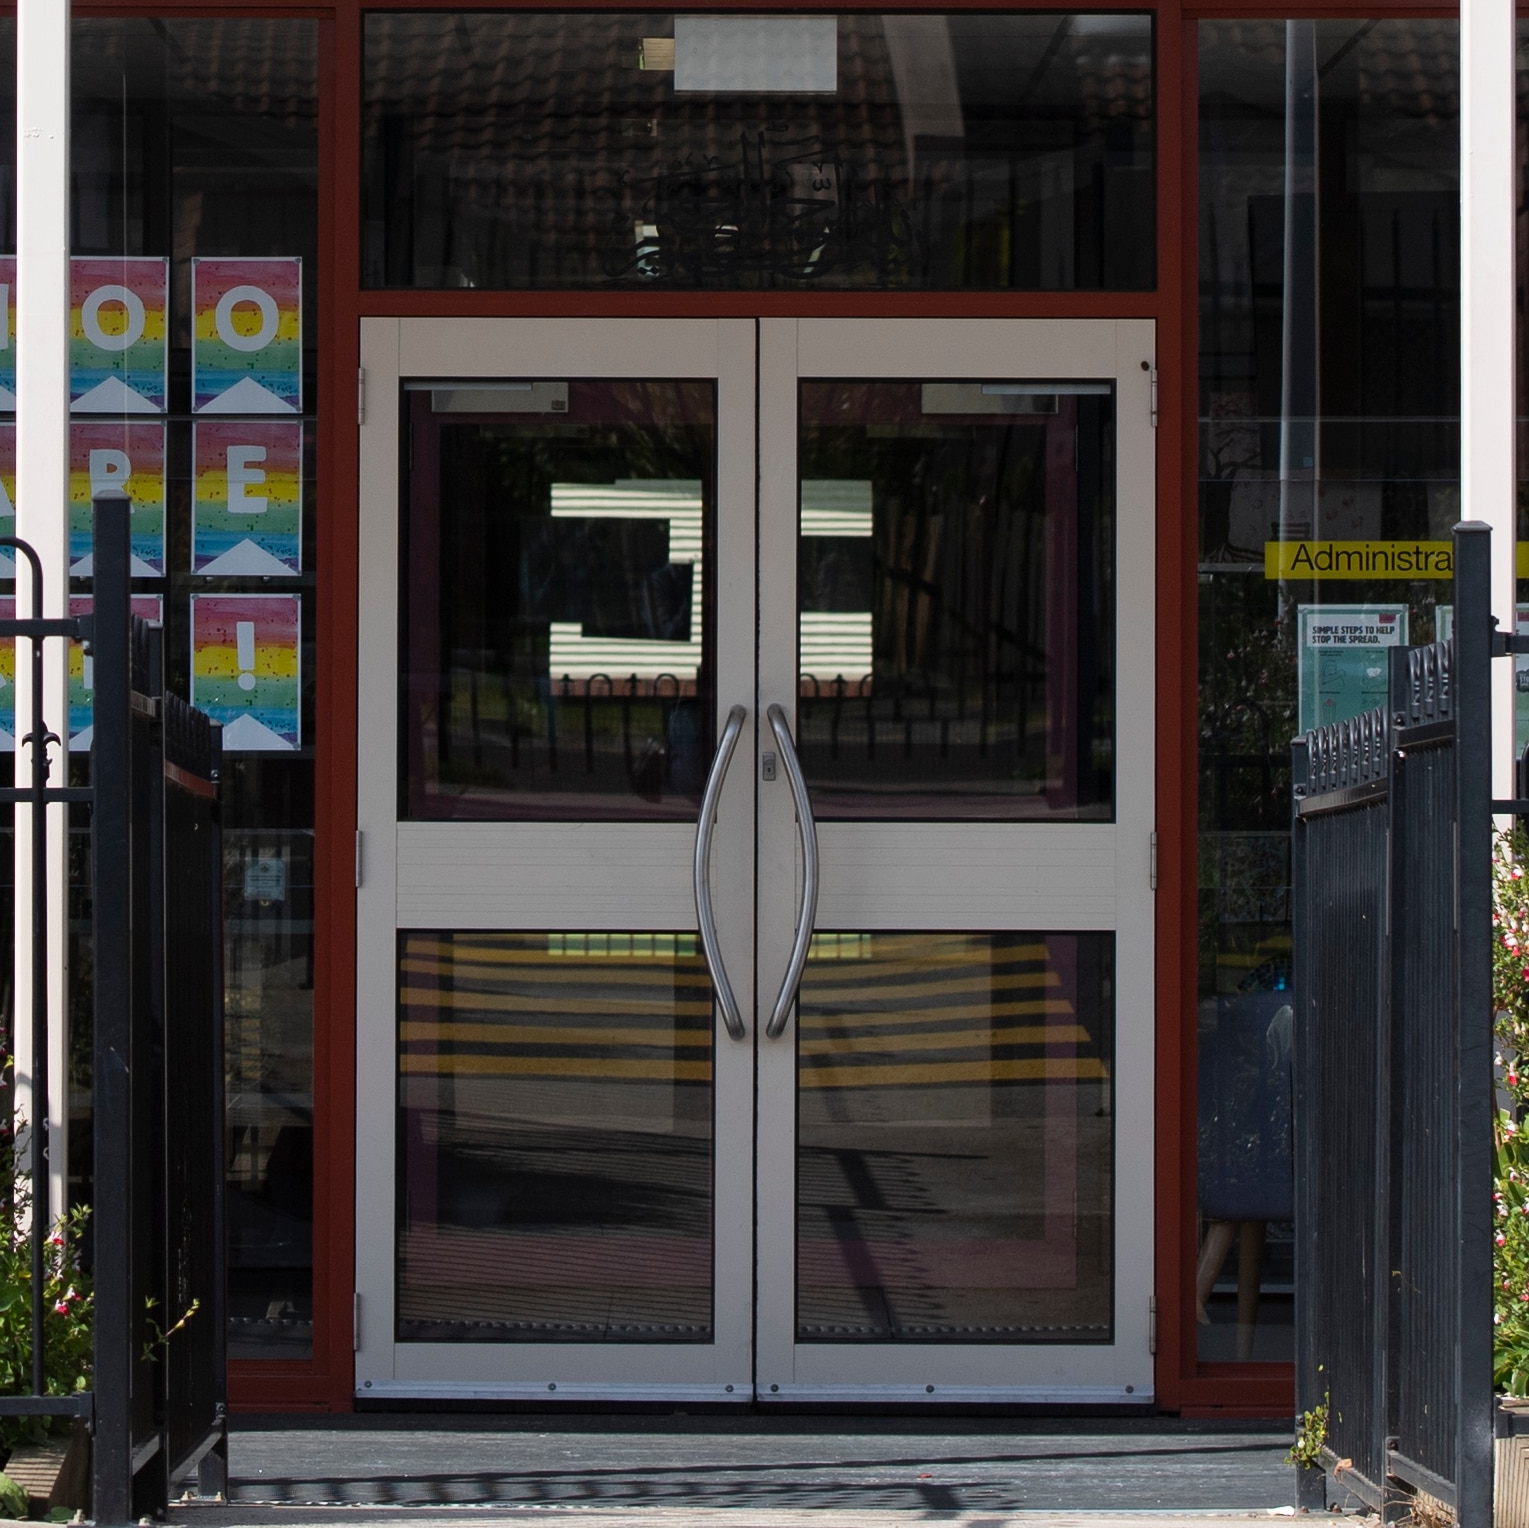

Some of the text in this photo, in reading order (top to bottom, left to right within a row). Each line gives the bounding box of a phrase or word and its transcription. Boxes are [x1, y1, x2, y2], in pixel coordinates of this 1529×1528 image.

[1312, 625, 1395, 635] SIMPLE STEPS TO HELP
[1312, 635, 1381, 644] STOP THE SPREAD.
